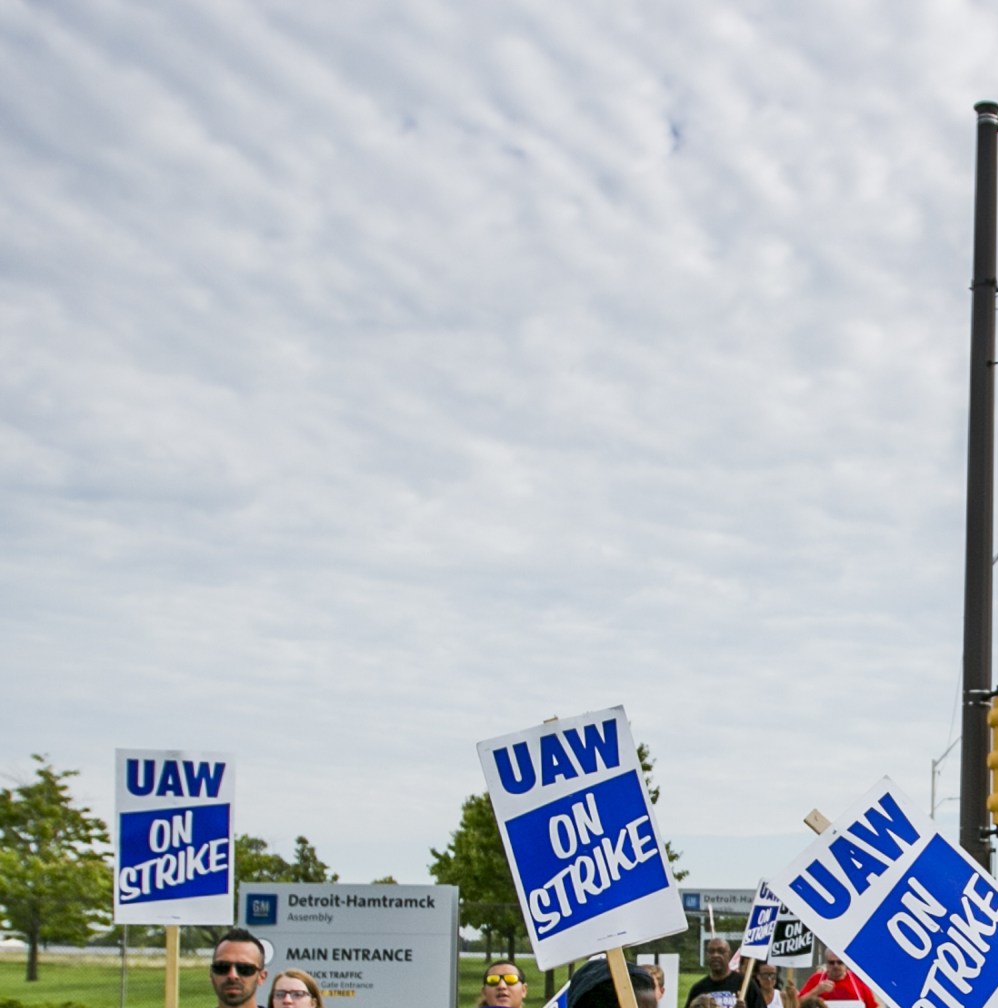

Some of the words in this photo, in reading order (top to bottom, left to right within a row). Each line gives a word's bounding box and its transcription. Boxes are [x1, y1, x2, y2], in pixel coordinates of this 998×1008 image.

[493, 718, 620, 794] UAW
[126, 758, 226, 798] UAW
[150, 811, 192, 853] ON
[549, 793, 604, 859] ON
[788, 791, 921, 920] UAW
[119, 838, 229, 901] STRIKE
[529, 815, 658, 935] STRIKE
[252, 900, 270, 913] GM
[288, 894, 435, 909] Detroit-Hamtramck
[287, 912, 334, 924] Assembly
[757, 907, 772, 925] ON
[887, 877, 947, 960] ON
[744, 921, 775, 945] STRIKE
[785, 921, 803, 939] ON
[286, 948, 328, 961] MAIN
[332, 948, 413, 962] ENTRANCE
[772, 931, 812, 956] STRIKE
[305, 971, 328, 979] UCK
[329, 971, 363, 979] TRAFFIC
